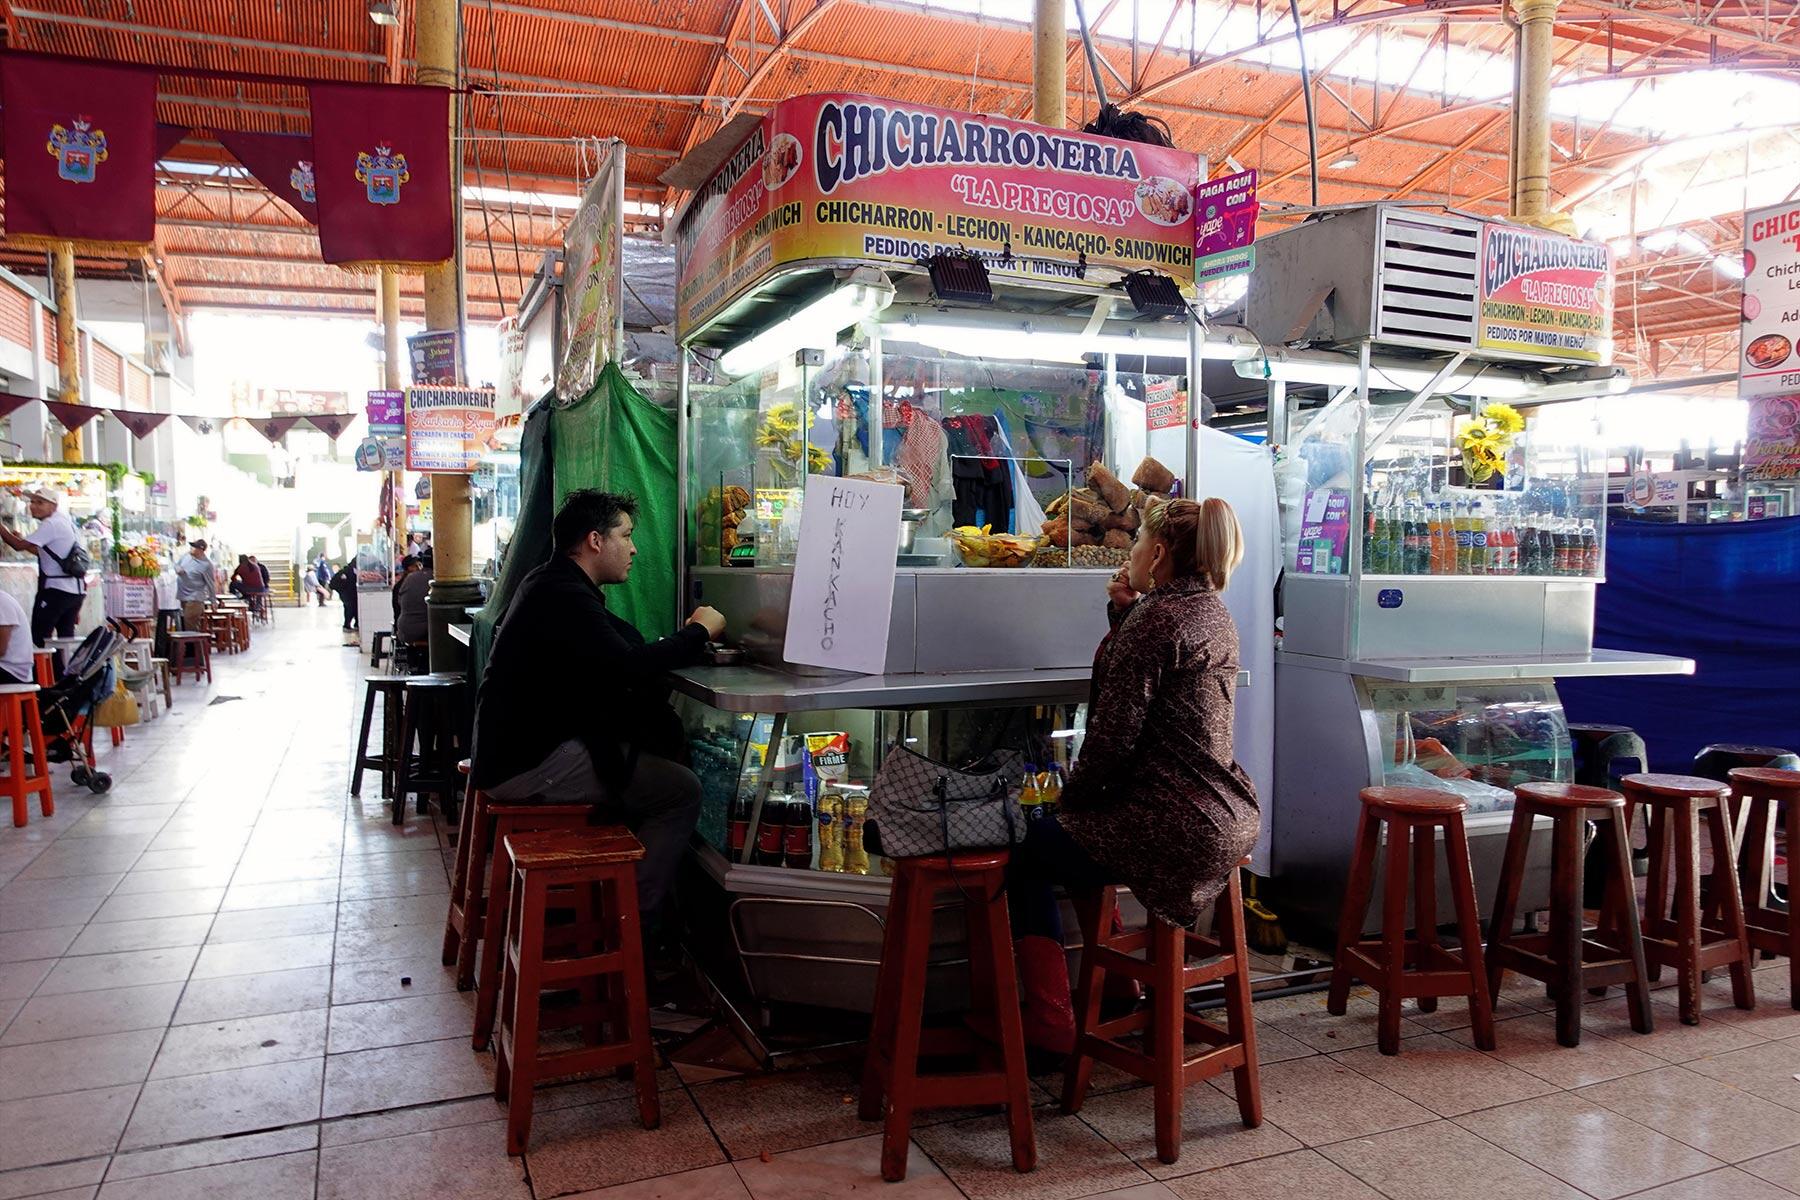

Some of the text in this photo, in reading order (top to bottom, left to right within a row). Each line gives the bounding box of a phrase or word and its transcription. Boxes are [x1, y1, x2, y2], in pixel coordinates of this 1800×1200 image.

[816, 103, 1140, 193] CHICHARRONERIA
[951, 173, 1135, 227] “LA PRECIOSA”
[1200, 182, 1224, 200] PAGA
[1226, 192, 1246, 206] CON
[816, 202, 934, 233] CHICHARRON
[947, 214, 1011, 242] LECHON
[1114, 238, 1192, 266] SANDWICH
[1196, 216, 1224, 249] yape
[864, 236, 930, 260] PEDIDOS
[1226, 251, 1248, 263] TODOS
[1200, 259, 1251, 278] PUEDEN YAPEAR
[1484, 230, 1608, 300] CHICHARRONERIA
[1481, 302, 1526, 323] CHICHARRON
[1529, 307, 1554, 325] LECHON
[1487, 325, 1517, 341] PEDIDOS
[1519, 329, 1532, 344] POR
[1535, 331, 1557, 346] MAYOR
[1559, 334, 1564, 347] Y
[410, 389, 488, 409] CHICHARRONERIA
[831, 486, 870, 511] HOY
[1326, 511, 1340, 521] CON
[1303, 526, 1323, 541] yape
[820, 517, 847, 652] KANKACHO
[819, 754, 846, 766] FIRME
